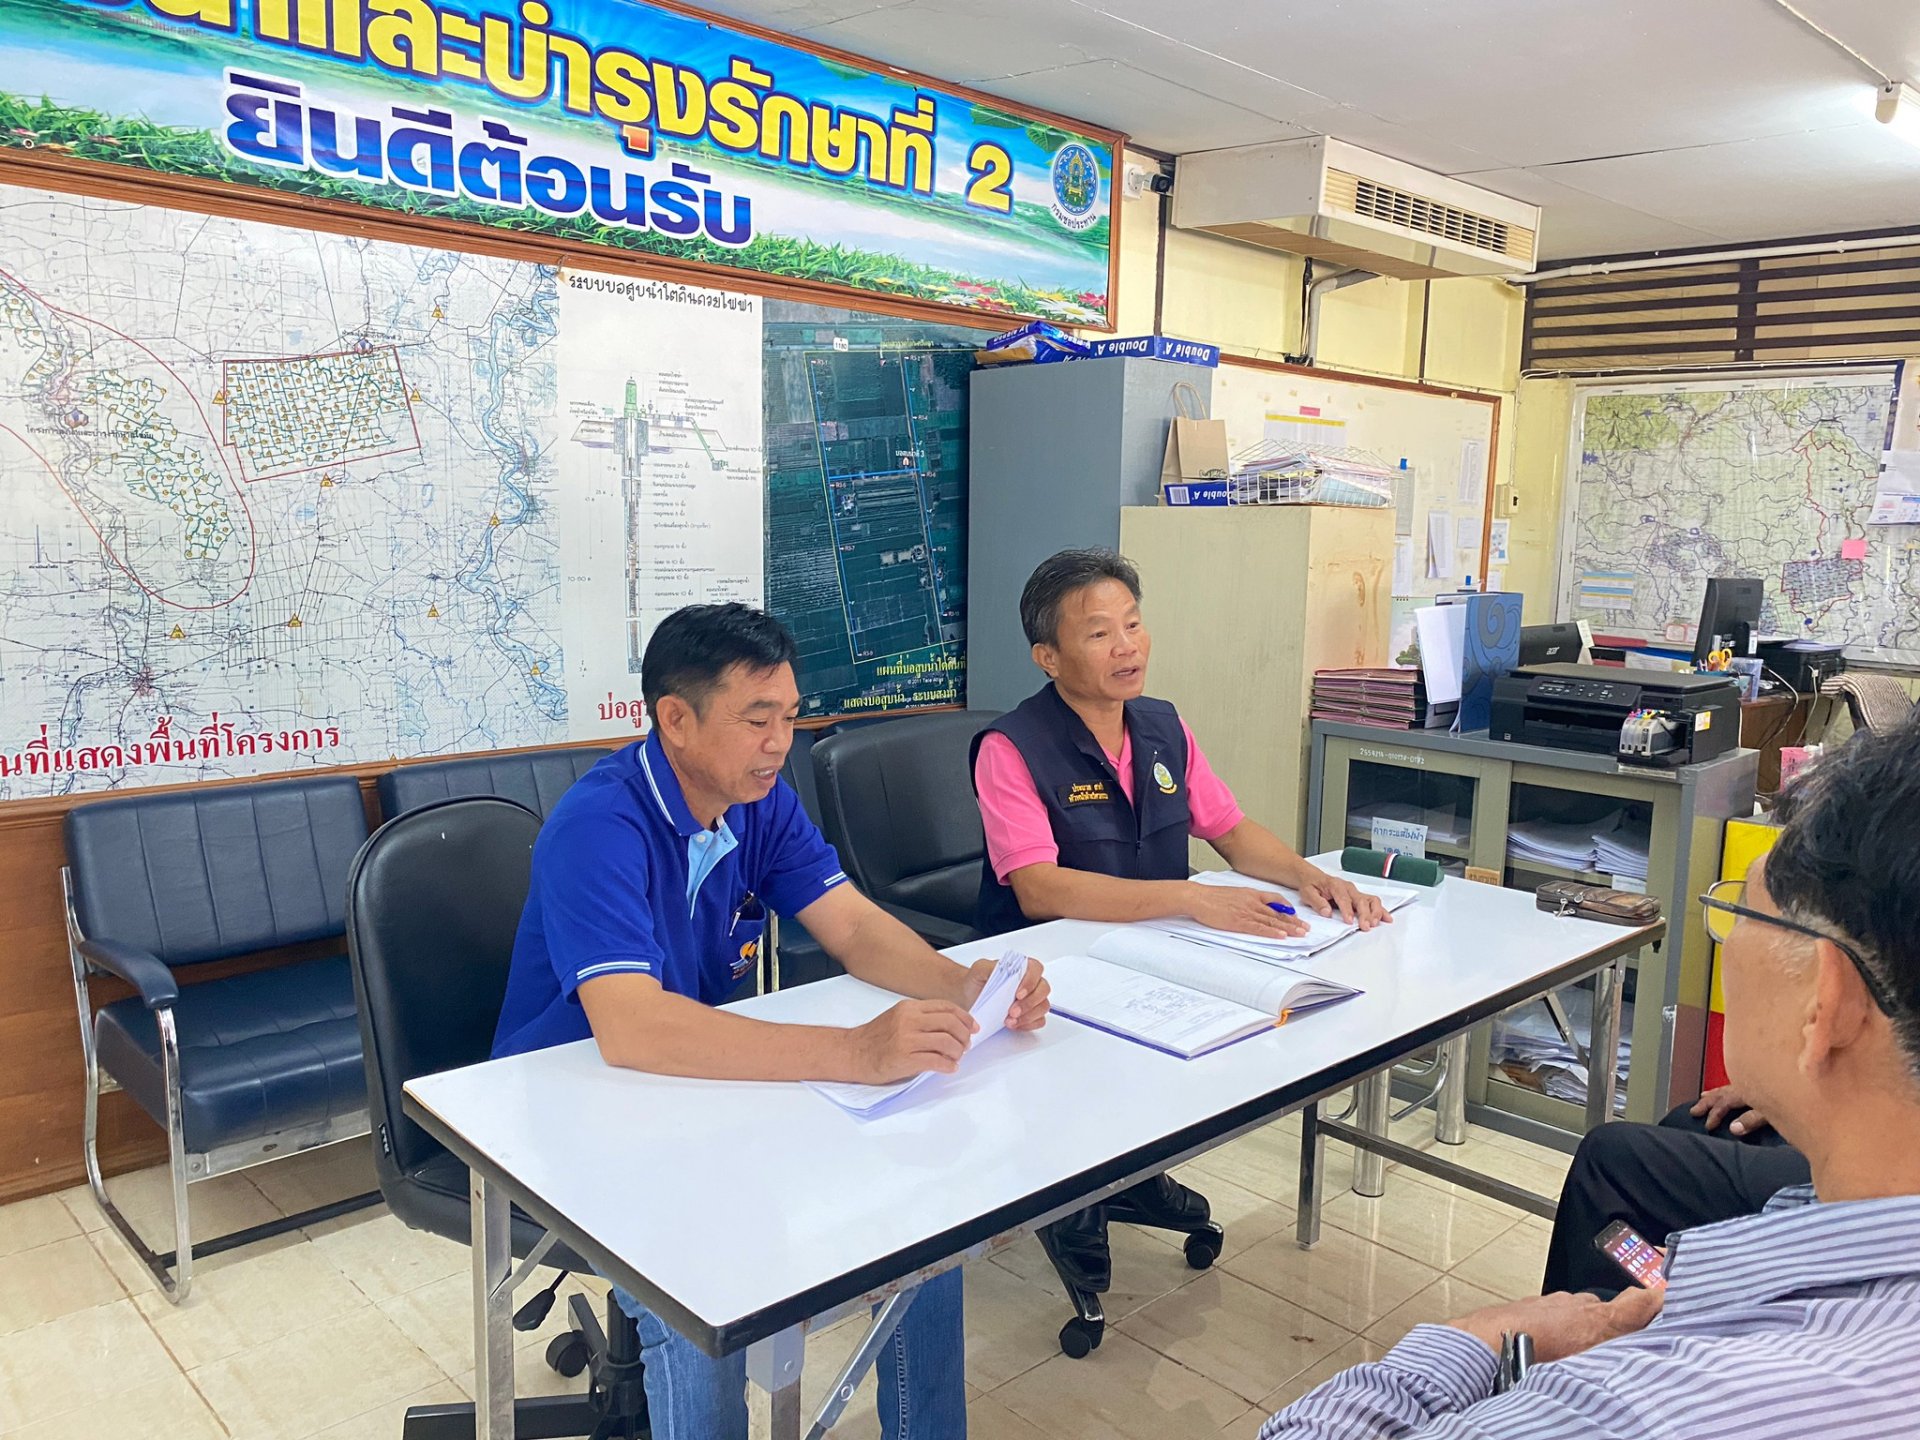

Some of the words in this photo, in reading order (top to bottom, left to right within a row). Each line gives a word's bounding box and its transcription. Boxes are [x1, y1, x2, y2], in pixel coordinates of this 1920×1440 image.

[225, 72, 754, 246] ยินดีต้อนรับ
[967, 141, 1013, 213] 2
[1096, 344, 1105, 355] A
[1108, 339, 1149, 356] Double
[1164, 342, 1173, 354] A
[1175, 344, 1211, 362] Double
[1202, 490, 1229, 500] ouble
[597, 691, 647, 728] บ่อสู
